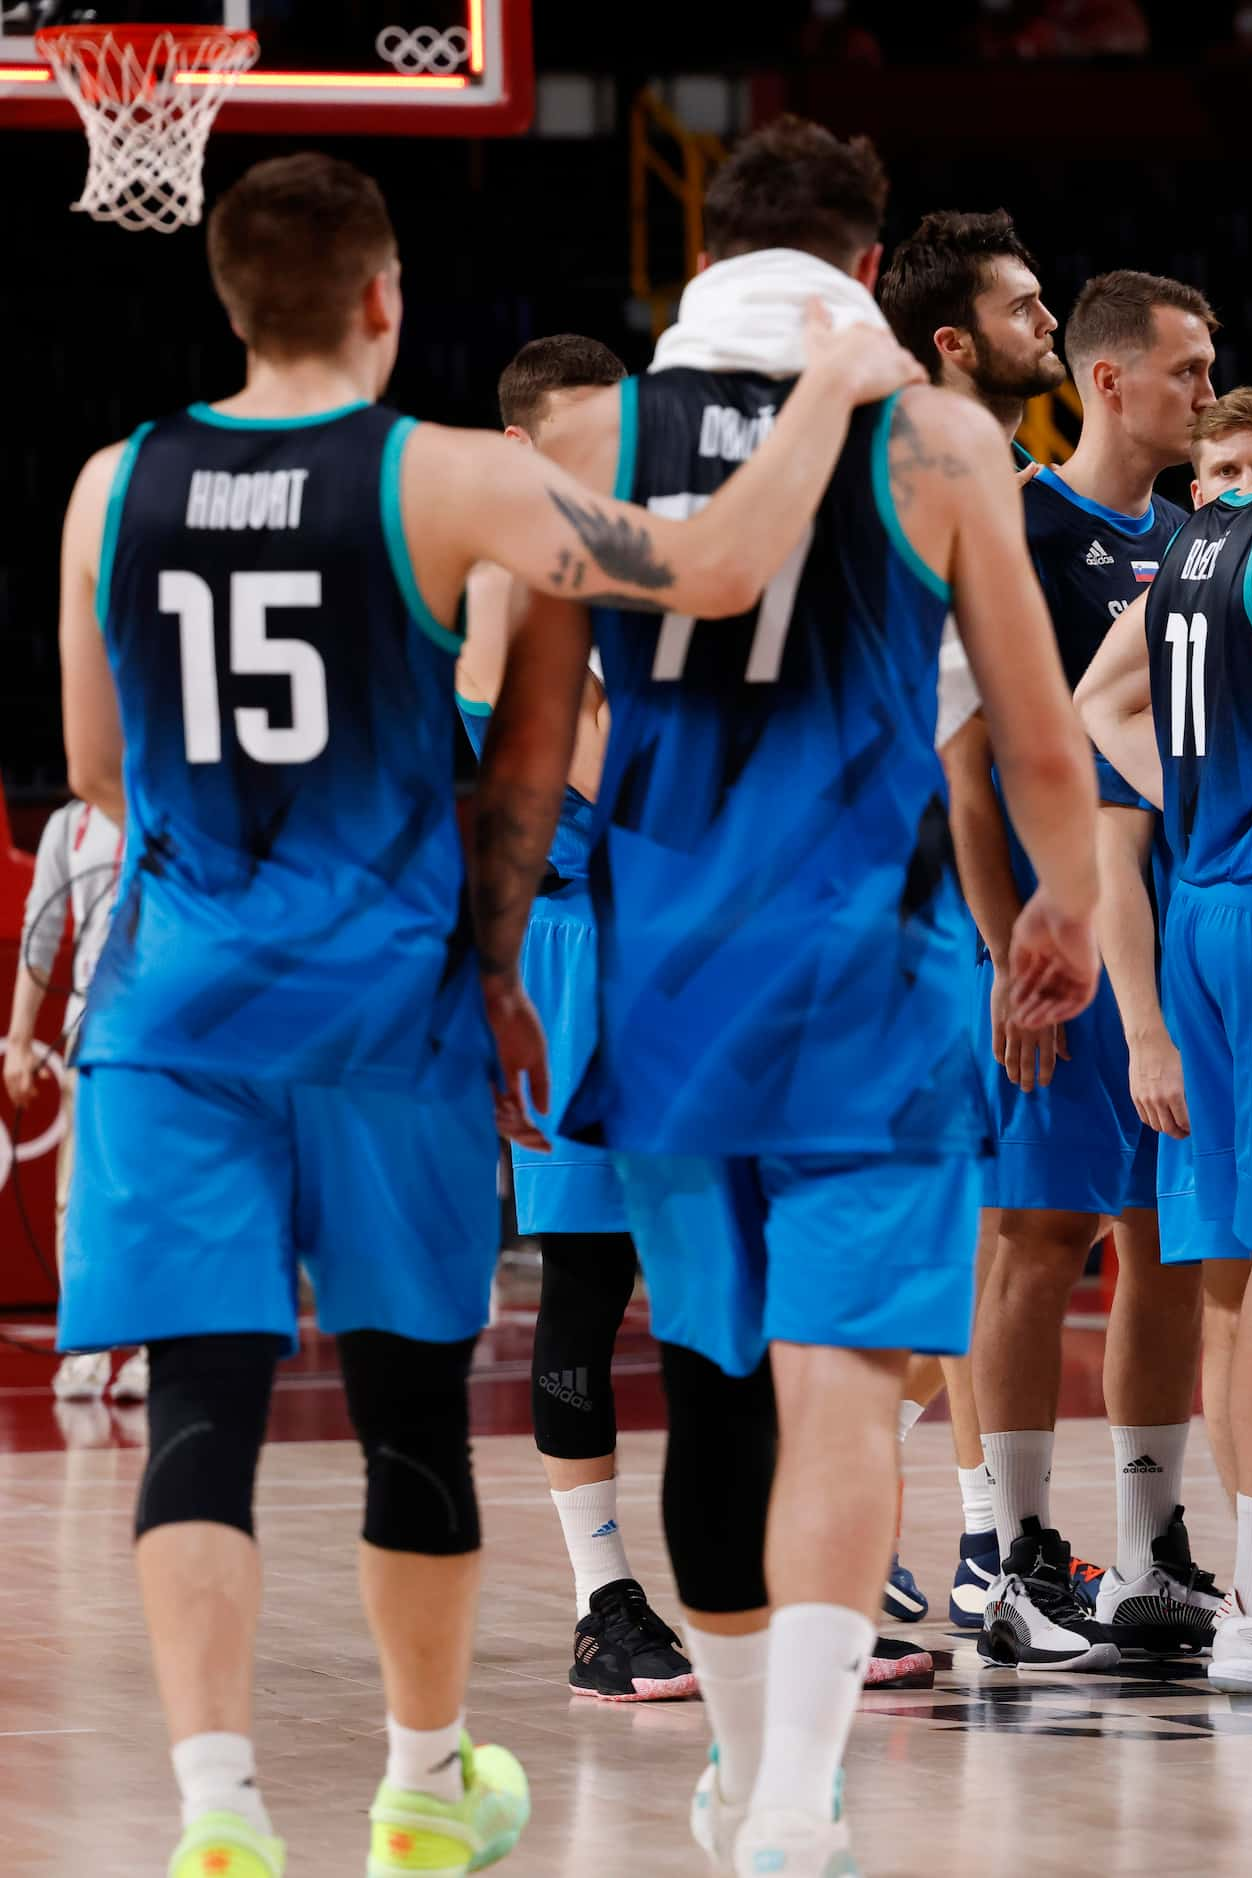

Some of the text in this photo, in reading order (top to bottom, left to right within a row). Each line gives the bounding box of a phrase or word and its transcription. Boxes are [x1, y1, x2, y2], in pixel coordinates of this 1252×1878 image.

[158, 569, 329, 764] 15
[1165, 612, 1208, 757] 11
[539, 1376, 593, 1413] adidas
[1123, 1465, 1164, 1473] adidas
